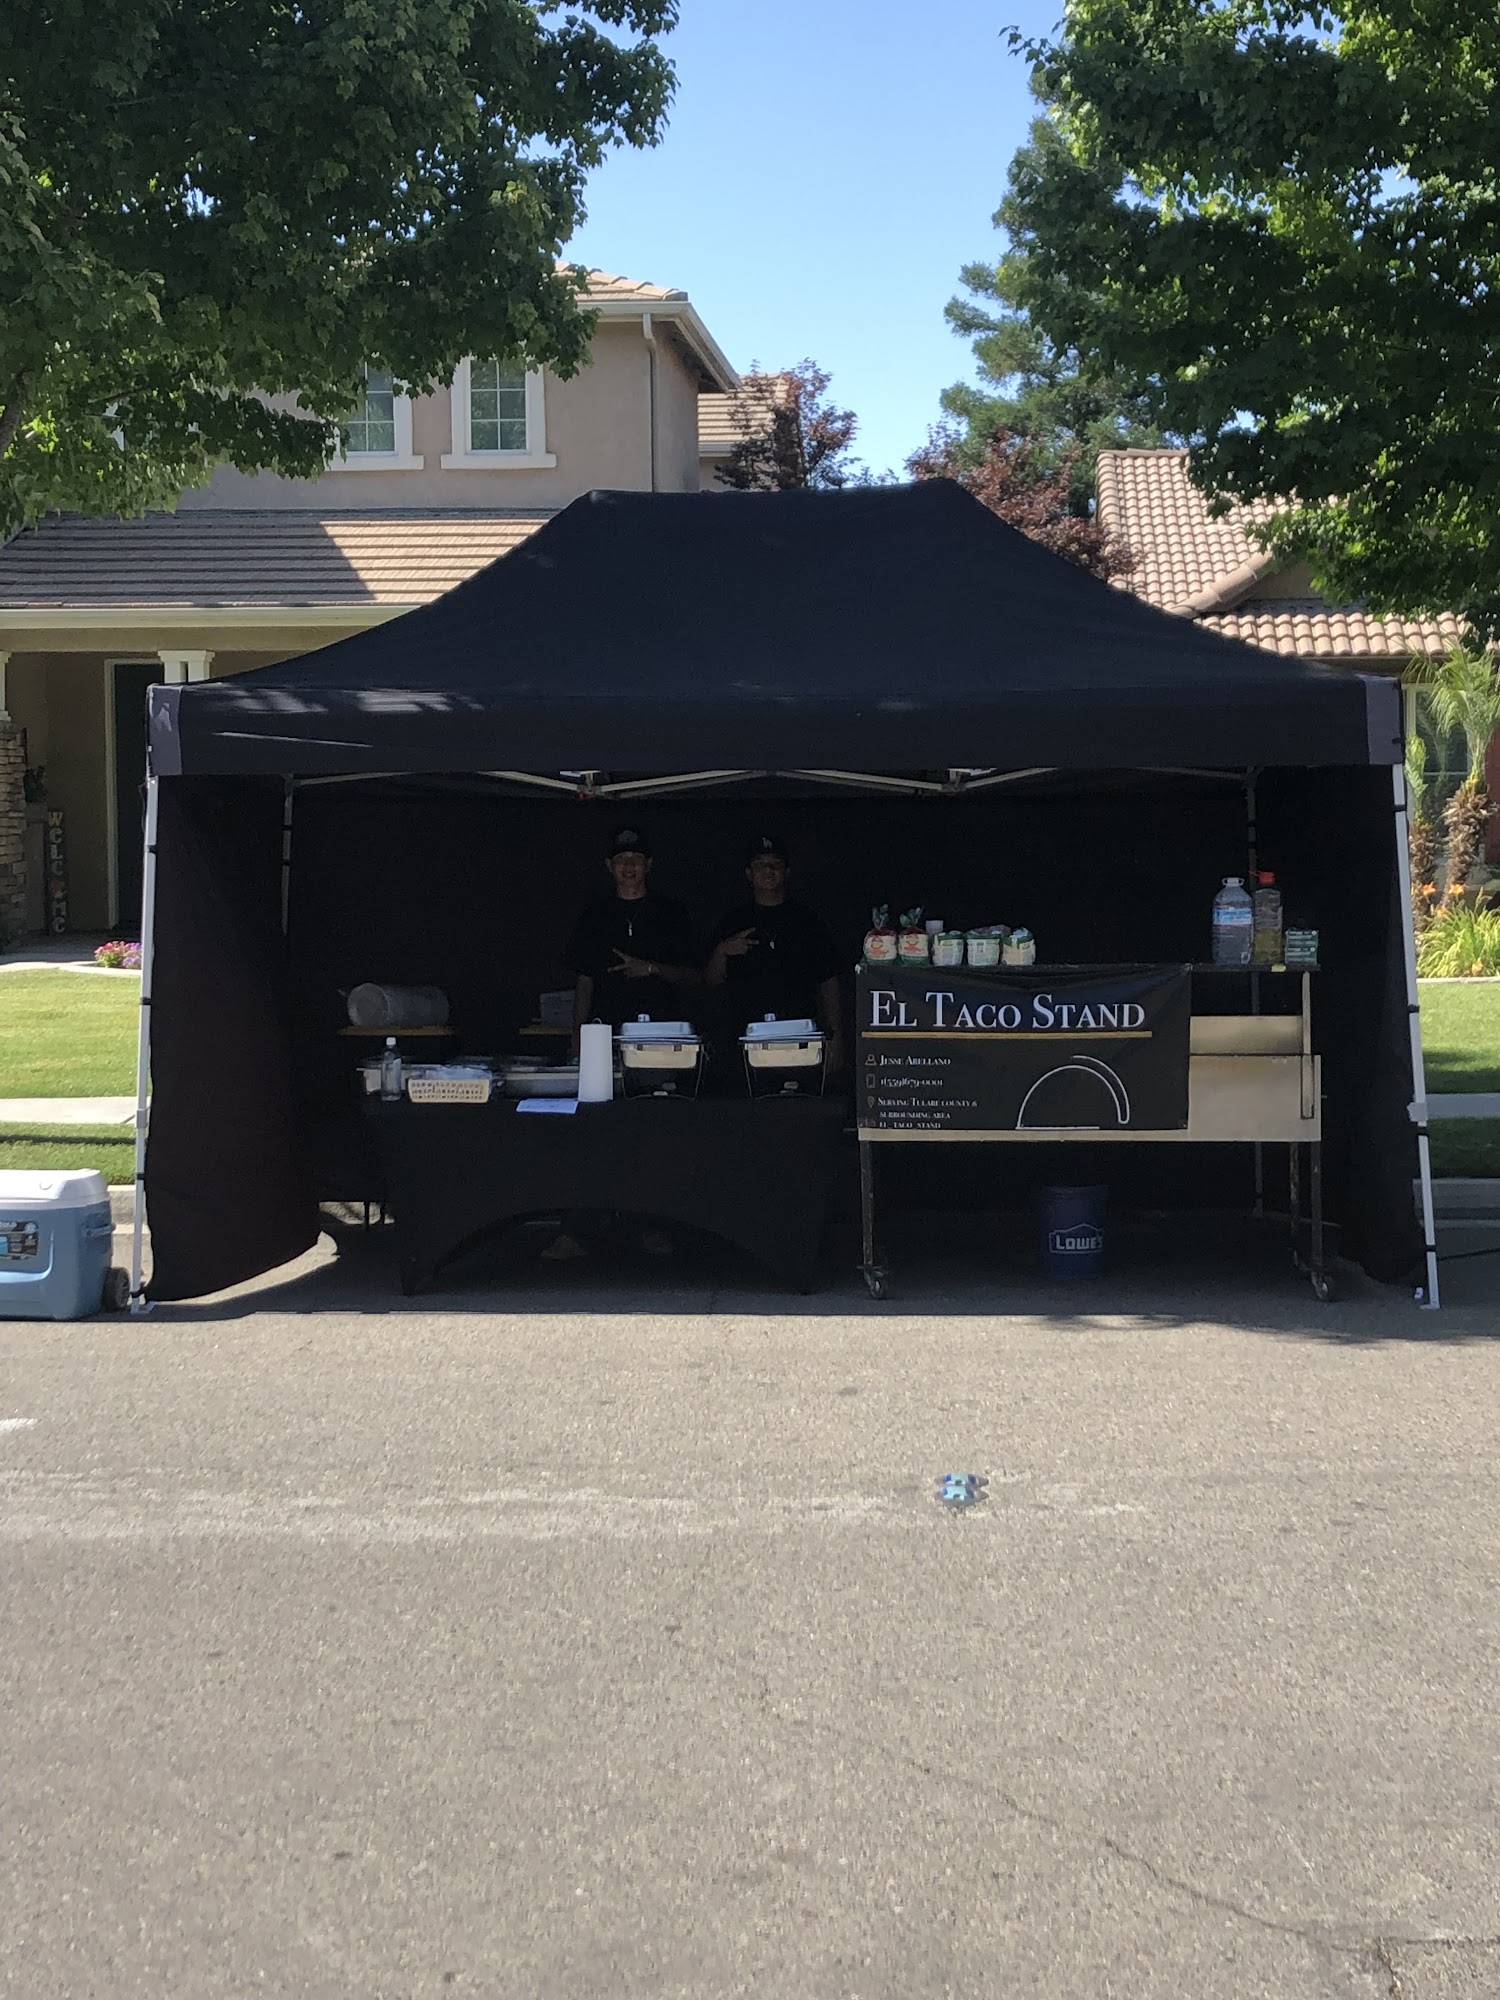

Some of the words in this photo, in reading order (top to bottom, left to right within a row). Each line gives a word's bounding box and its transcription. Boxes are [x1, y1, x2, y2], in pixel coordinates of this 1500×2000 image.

[869, 990, 917, 1027] EL
[925, 991, 1022, 1028] TACO
[1032, 994, 1145, 1029] STAND
[1055, 1234, 1103, 1250] LOWE'S
